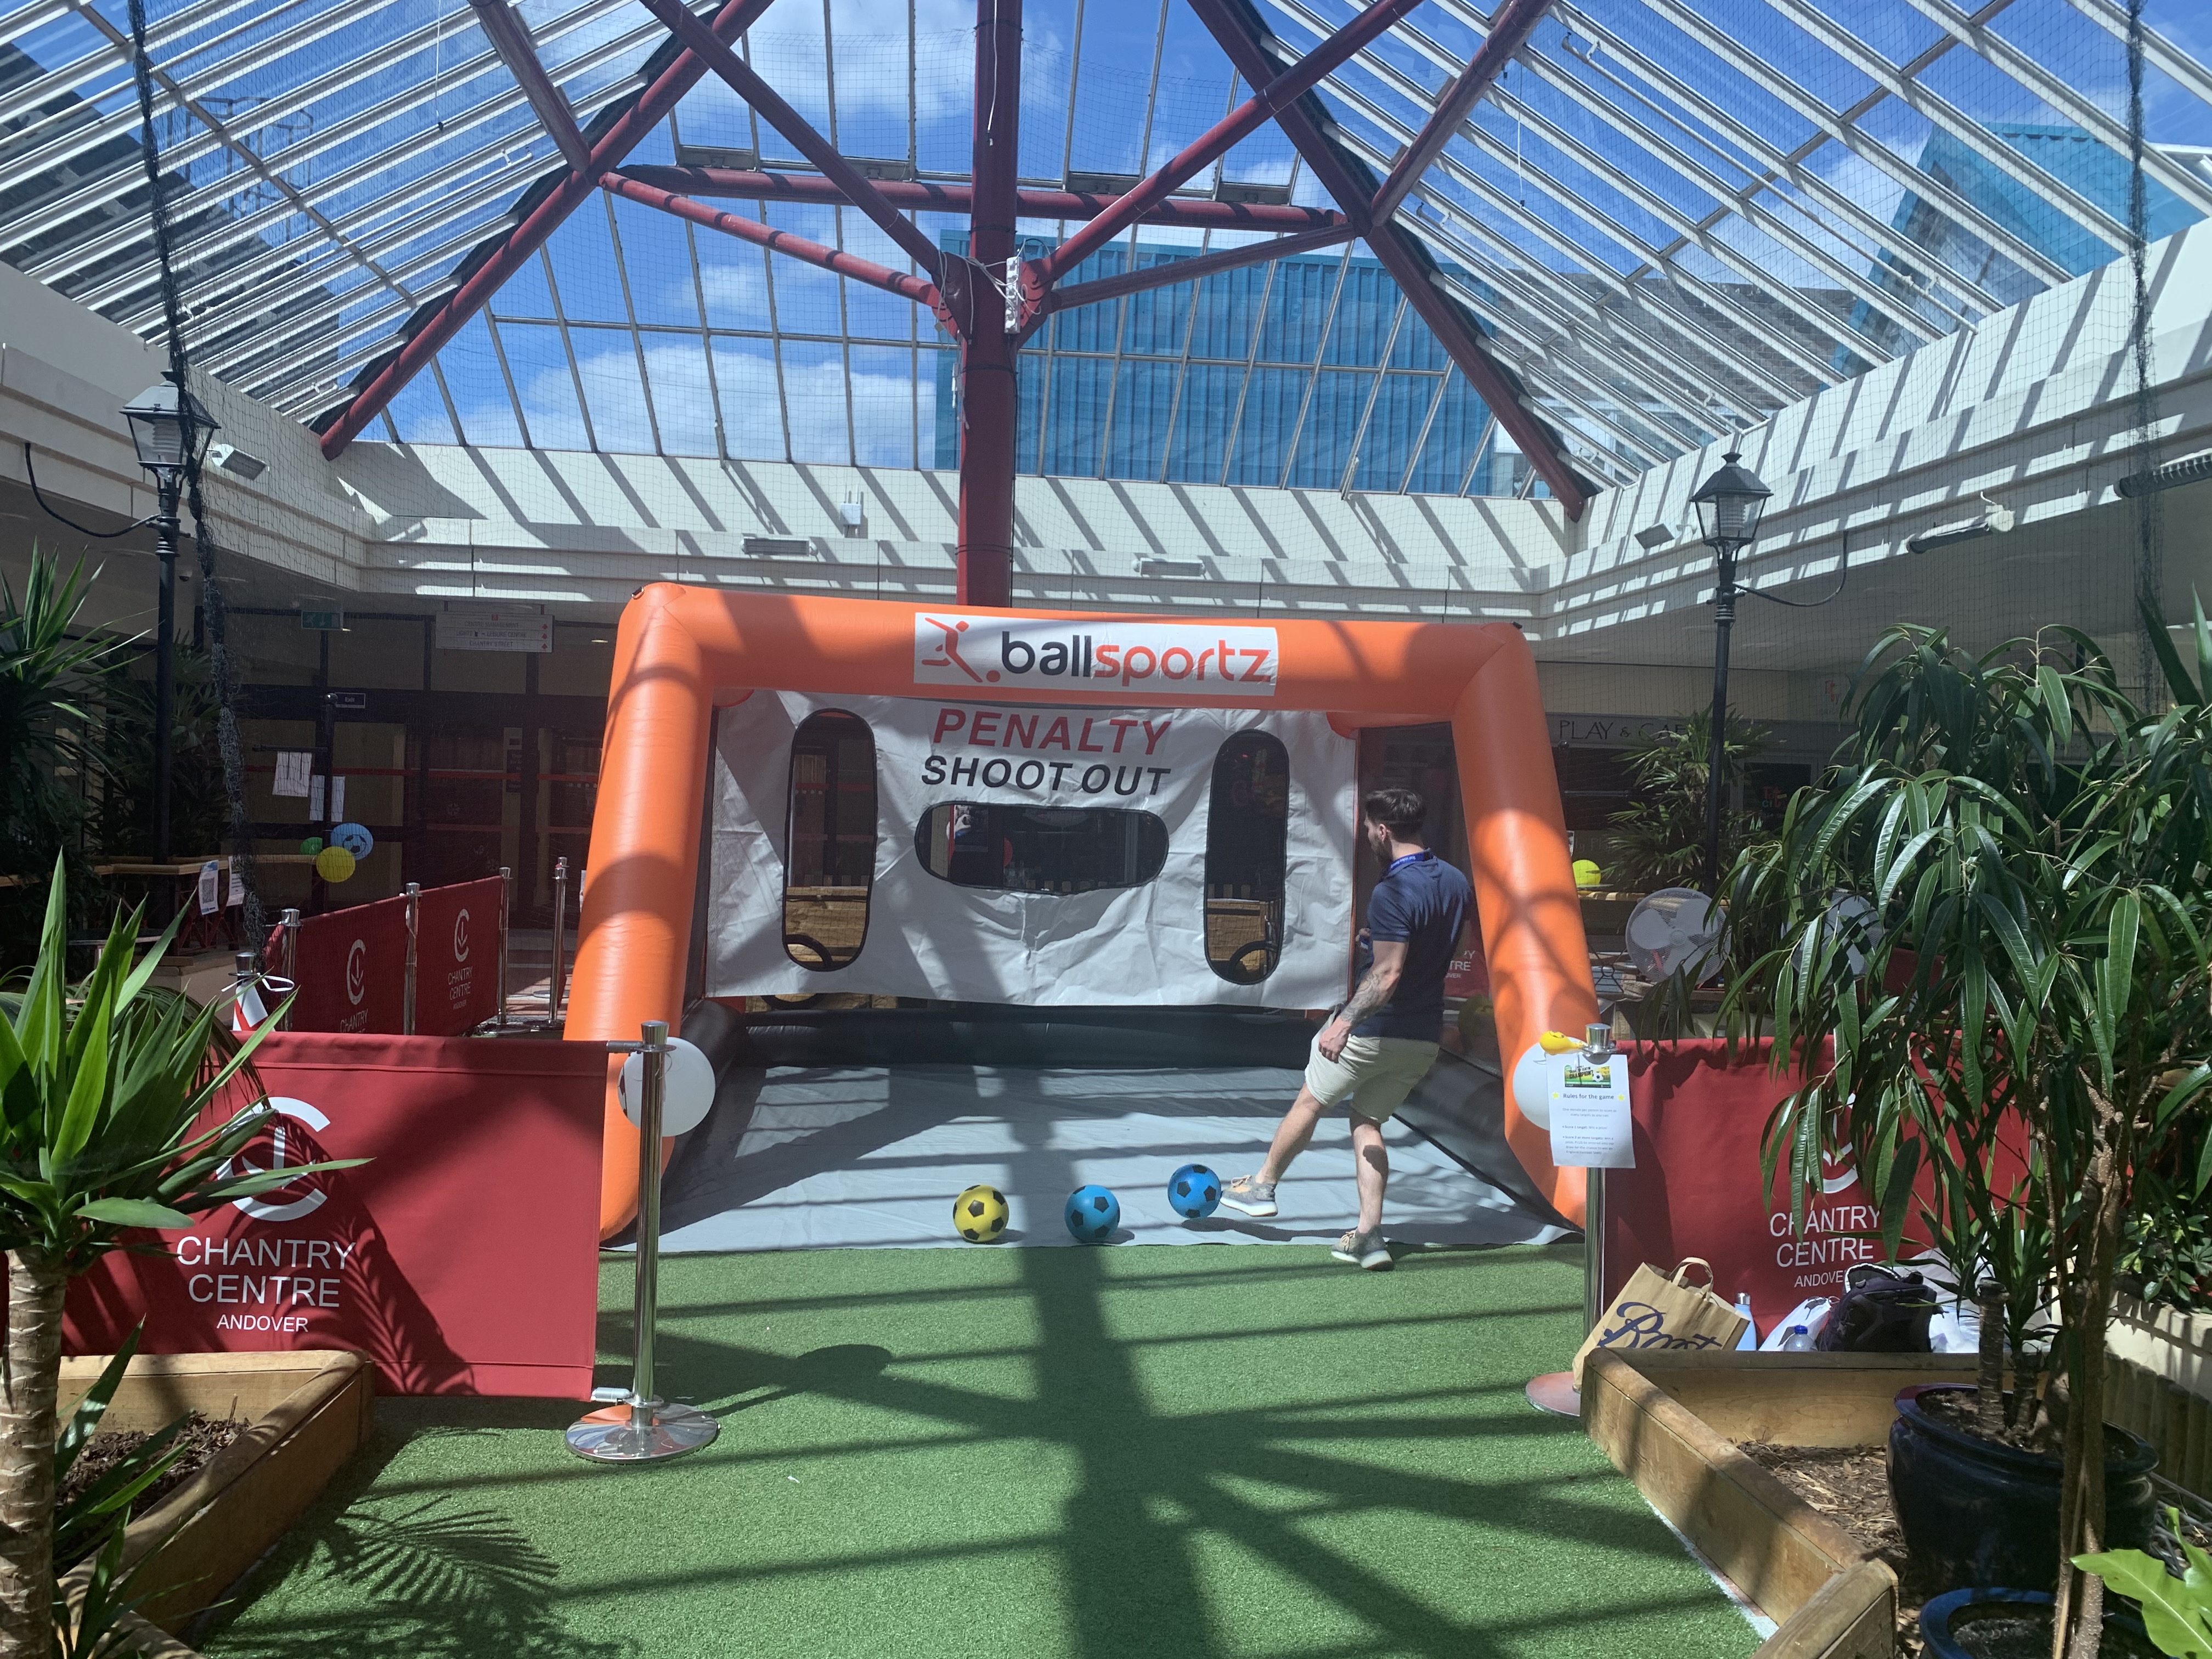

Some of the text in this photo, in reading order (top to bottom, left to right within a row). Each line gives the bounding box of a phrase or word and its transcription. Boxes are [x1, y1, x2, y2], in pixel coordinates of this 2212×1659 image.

[1001, 630, 1272, 687] ballsportz
[933, 708, 1172, 755] PENALTY
[1559, 720, 1613, 740] PLAY
[921, 755, 1171, 796] SHOOT OUT
[448, 966, 472, 985] CHANTRY
[449, 982, 471, 1000] CENTRE
[340, 1009, 368, 1033] CHANTRY
[177, 1235, 357, 1270] CHANTRY
[1776, 1237, 1874, 1268] CENTRE
[188, 1273, 341, 1307] CENTRE
[1794, 1270, 1844, 1288] ANDOVE
[216, 1314, 309, 1333] ANDOVER
